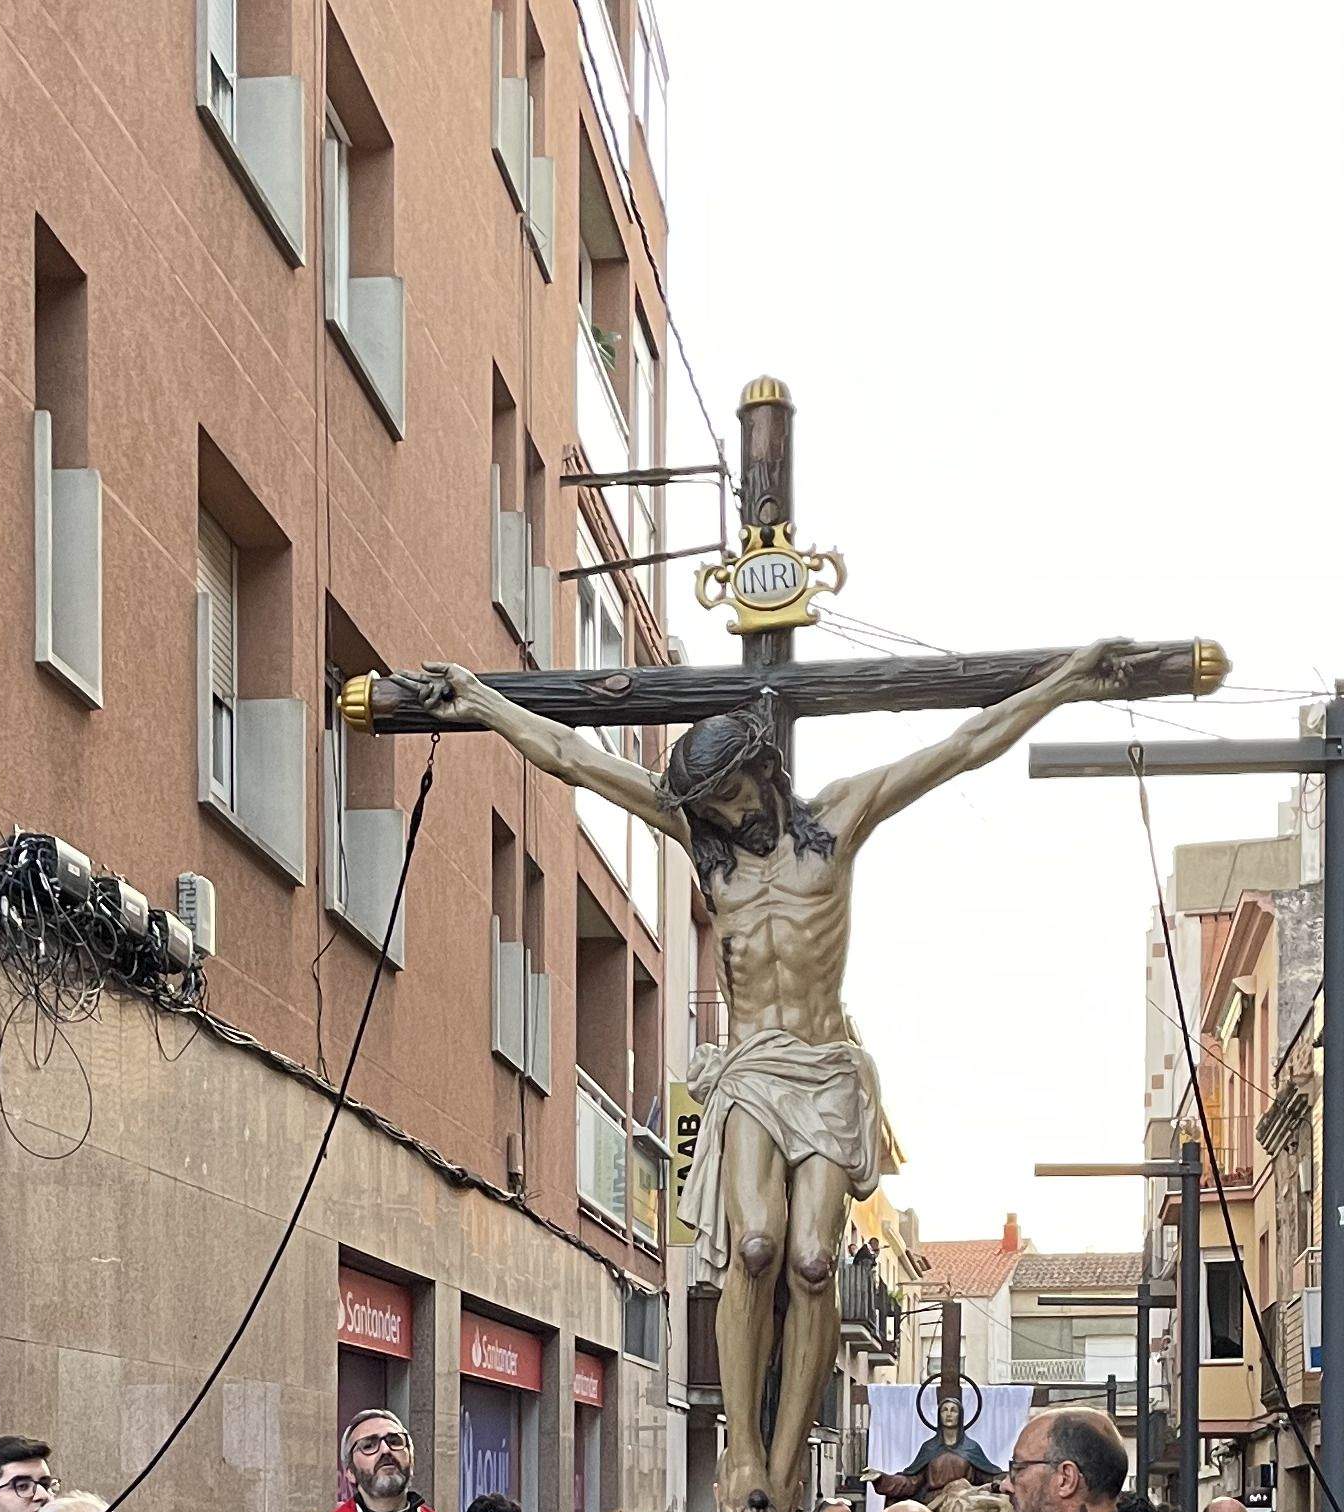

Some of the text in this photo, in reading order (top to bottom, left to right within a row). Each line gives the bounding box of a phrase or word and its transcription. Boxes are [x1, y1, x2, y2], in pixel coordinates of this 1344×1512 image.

[742, 563, 797, 594] INRI
[346, 1291, 402, 1344] Santander
[482, 1335, 519, 1376] Santander
[573, 1372, 599, 1400] antander
